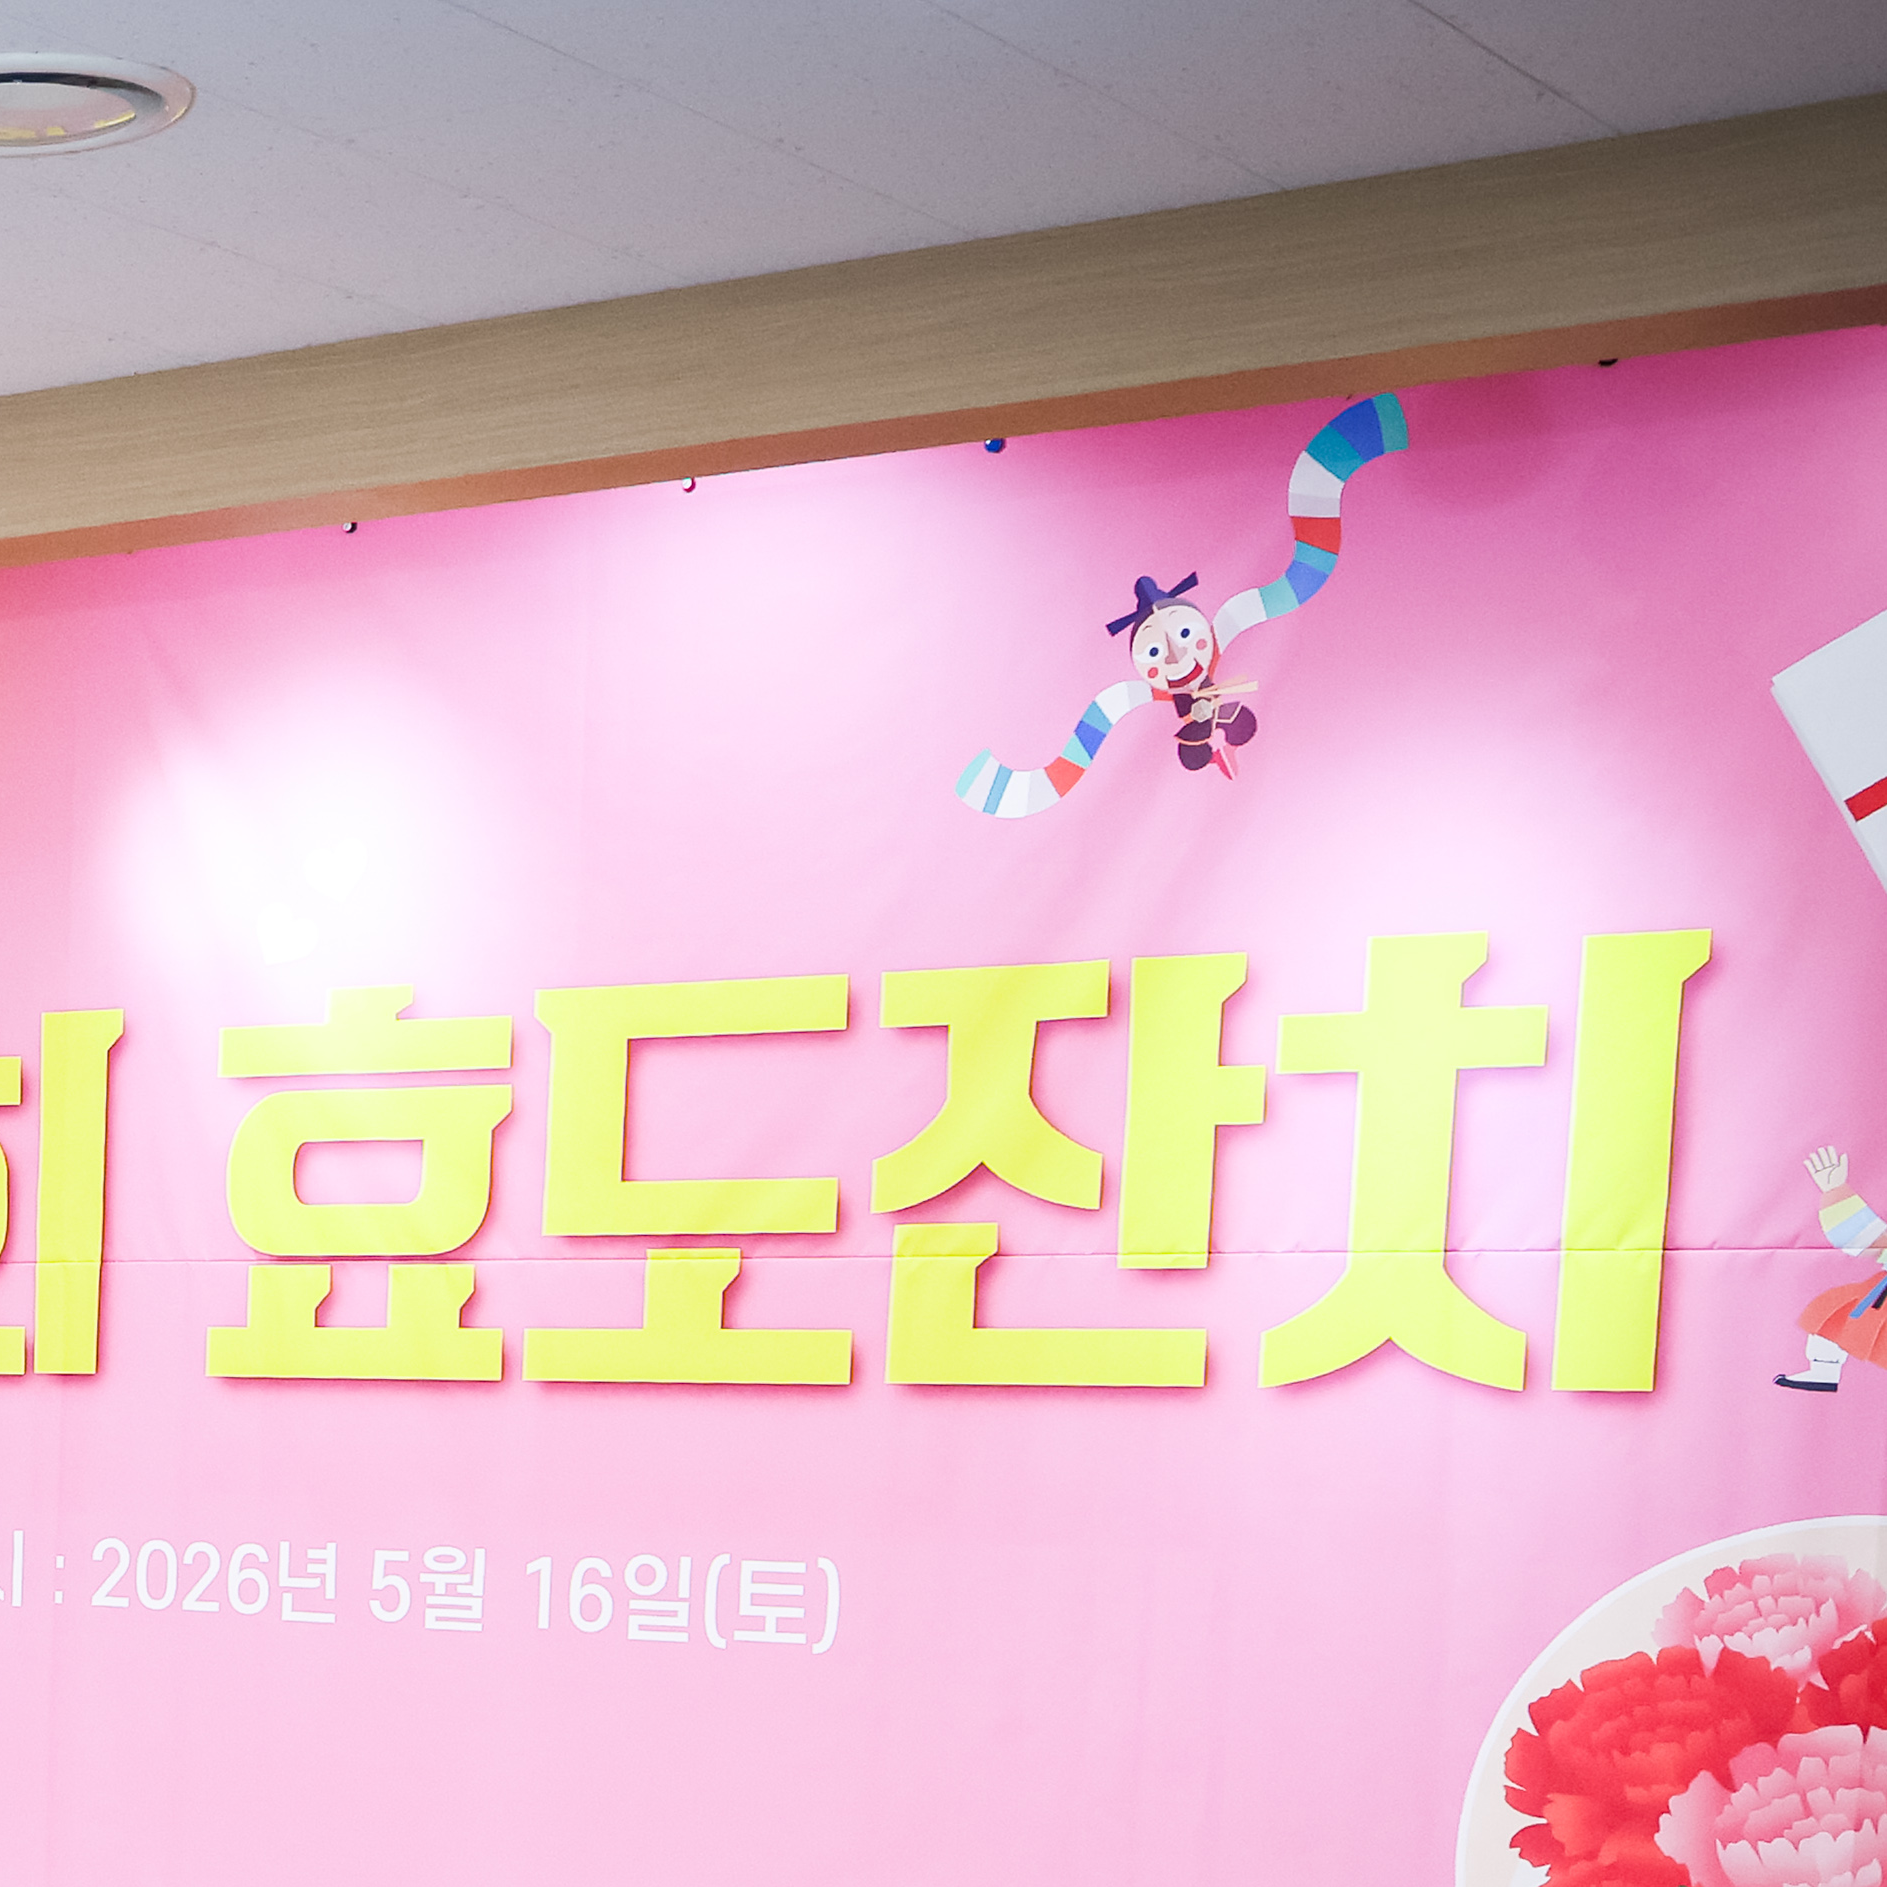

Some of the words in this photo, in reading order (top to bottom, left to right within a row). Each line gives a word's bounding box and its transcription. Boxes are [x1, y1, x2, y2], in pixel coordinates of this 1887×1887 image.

[206, 928, 1712, 1392] 효도잔치
[54, 1554, 65, 1605] :
[90, 1537, 337, 1624] 2026년
[369, 1545, 486, 1632] 5월
[525, 1553, 840, 1655] 16일(토)
